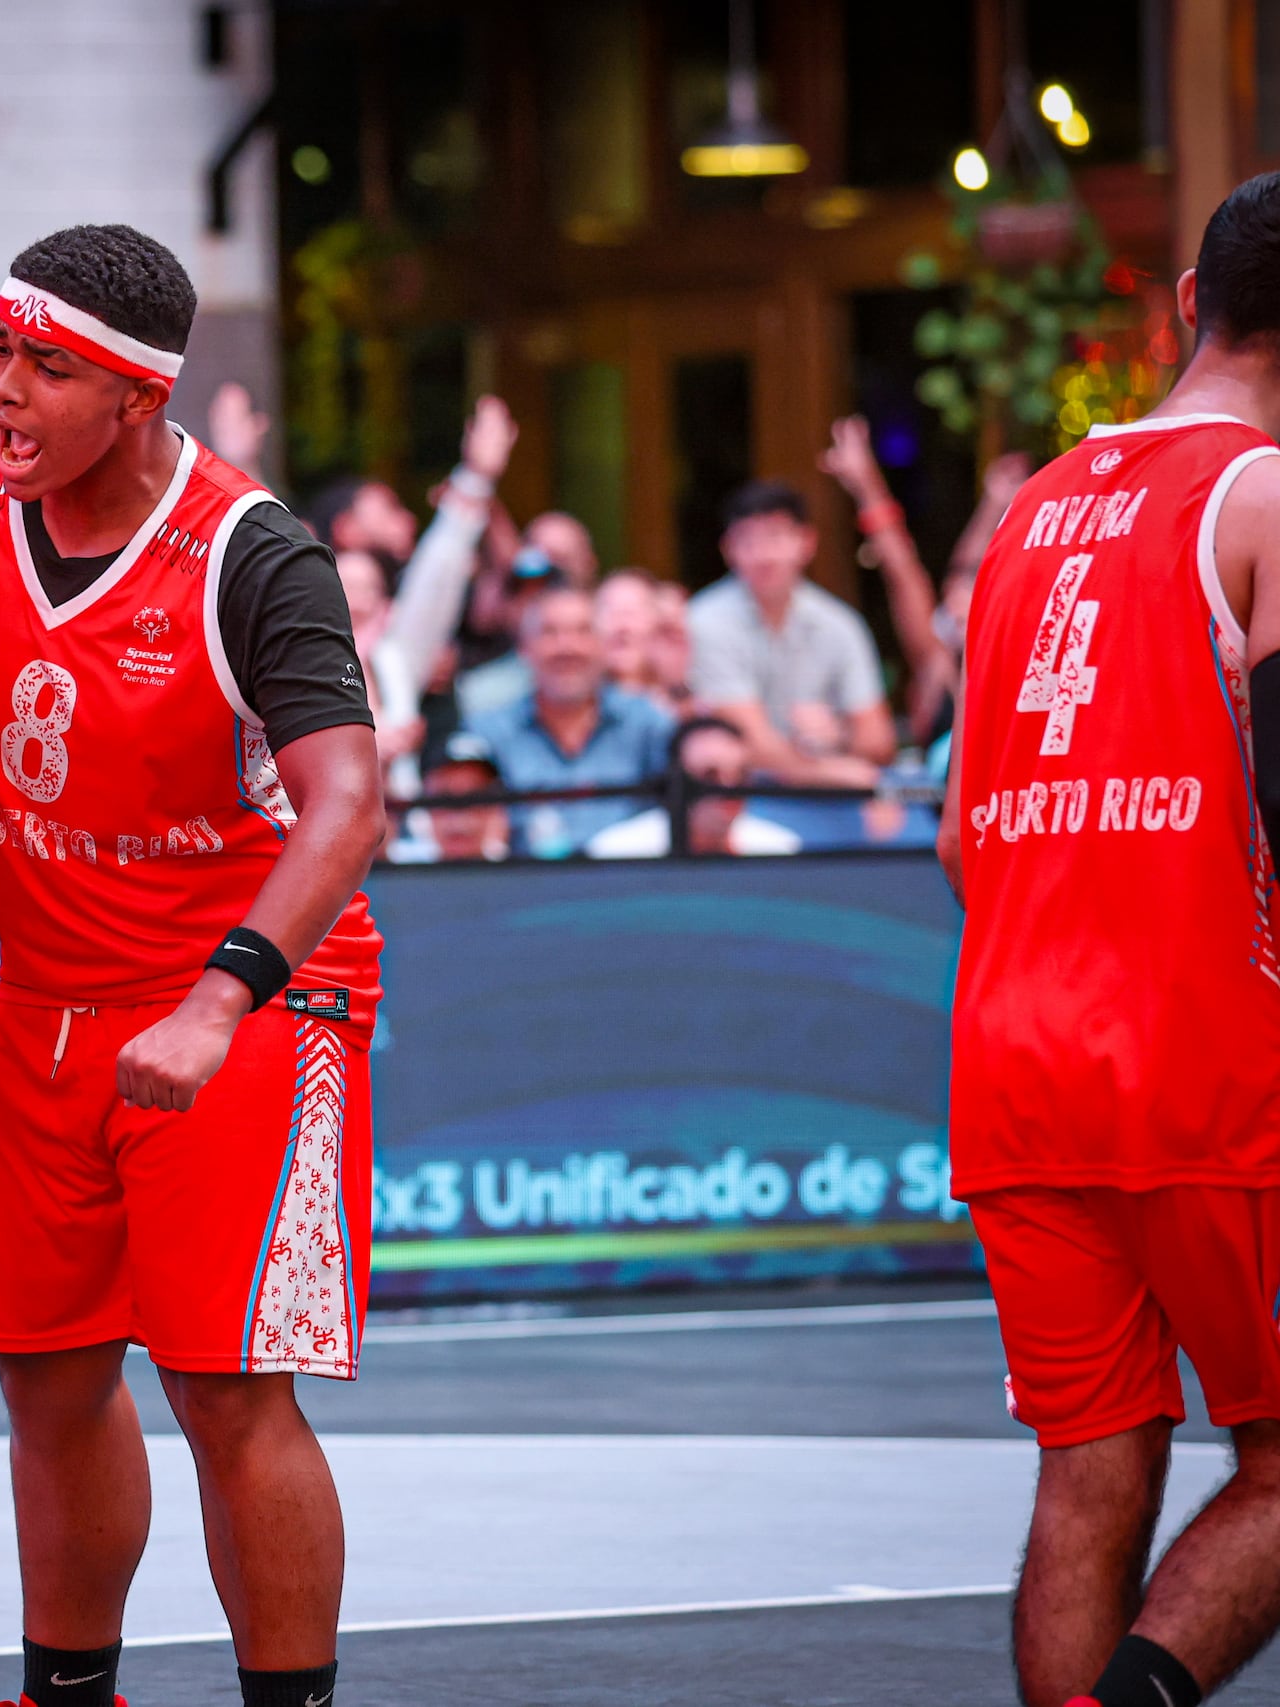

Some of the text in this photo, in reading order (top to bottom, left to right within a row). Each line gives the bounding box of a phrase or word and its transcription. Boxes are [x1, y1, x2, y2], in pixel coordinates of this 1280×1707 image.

[117, 658, 176, 675] Olympics
[122, 672, 166, 687] Puerto Rico
[125, 647, 173, 662] Special
[1016, 552, 1100, 756] 4
[0, 659, 78, 803] 8
[1098, 776, 1202, 832] RICO
[117, 815, 223, 866] RICO
[473, 1146, 789, 1229] Unificado
[798, 1142, 889, 1215] de
